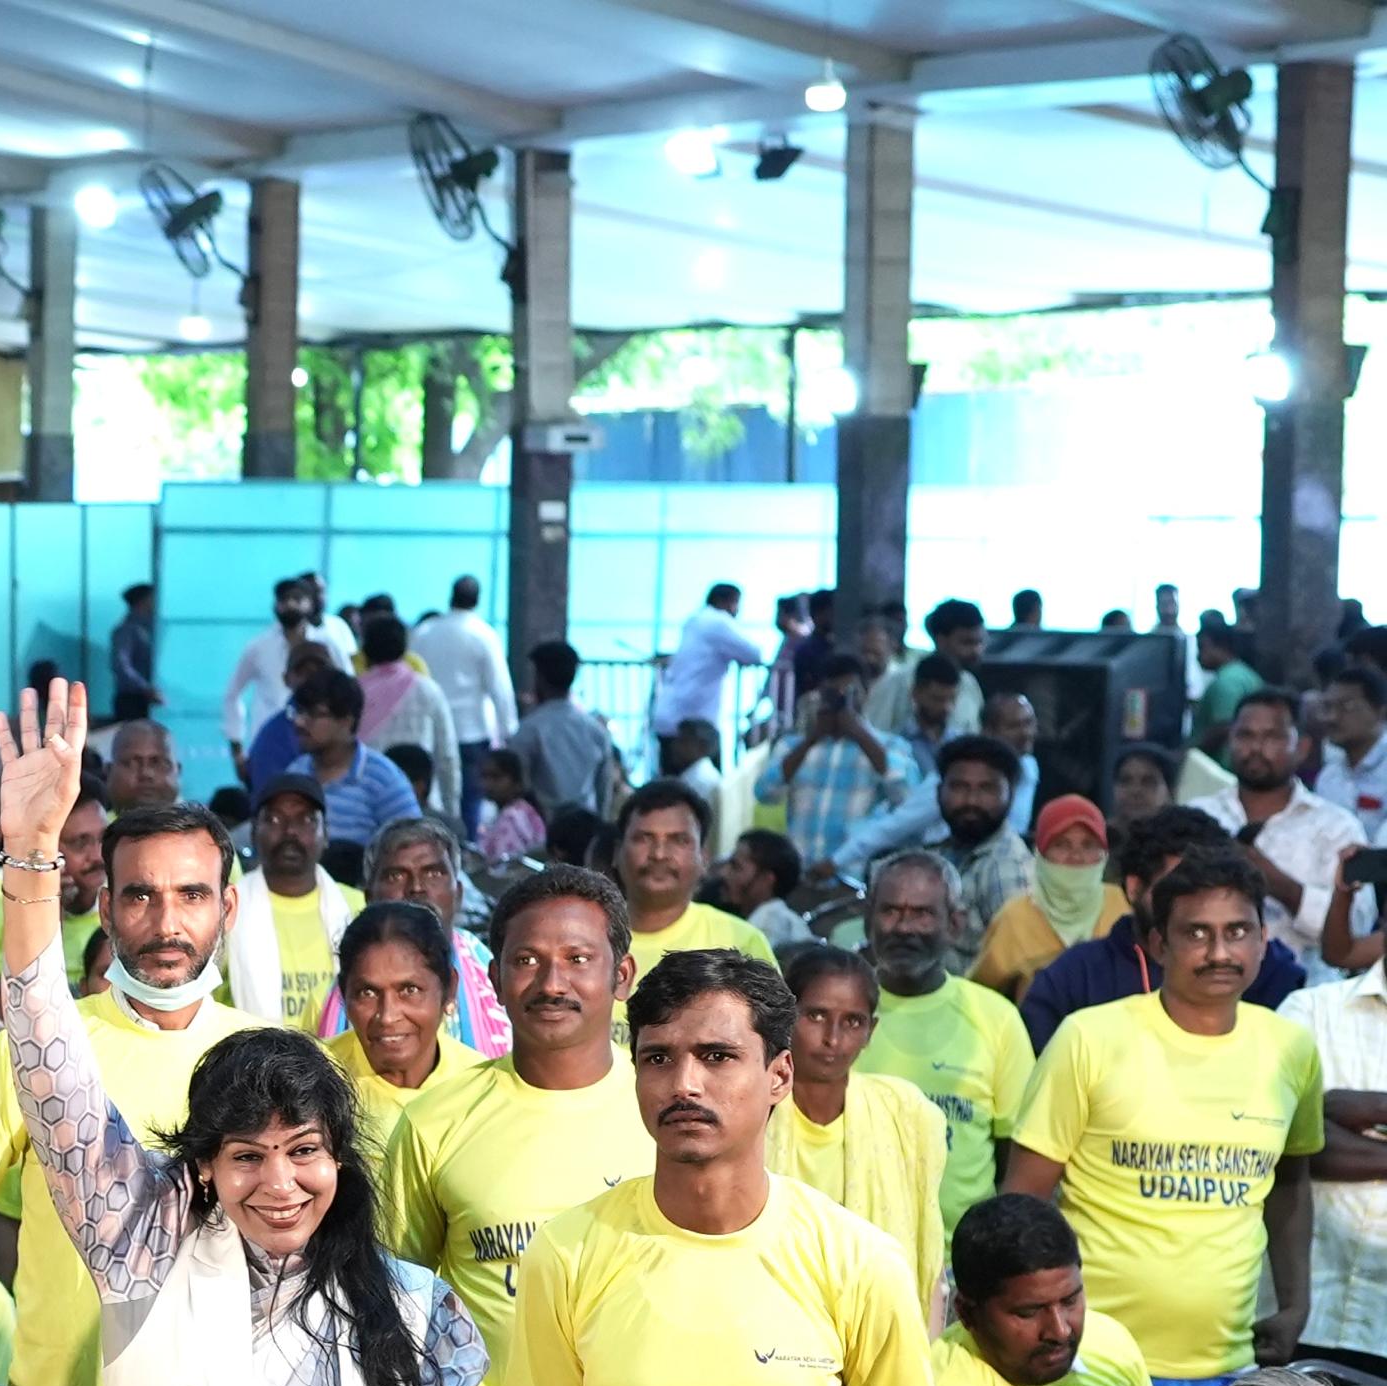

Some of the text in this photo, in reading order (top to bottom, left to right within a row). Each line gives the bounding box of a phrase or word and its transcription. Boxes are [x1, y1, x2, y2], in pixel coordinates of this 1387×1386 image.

[1111, 1139, 1173, 1171] NARAYAN
[1178, 1143, 1212, 1173] SEVA
[1138, 1173, 1252, 1207] UDAIPUR
